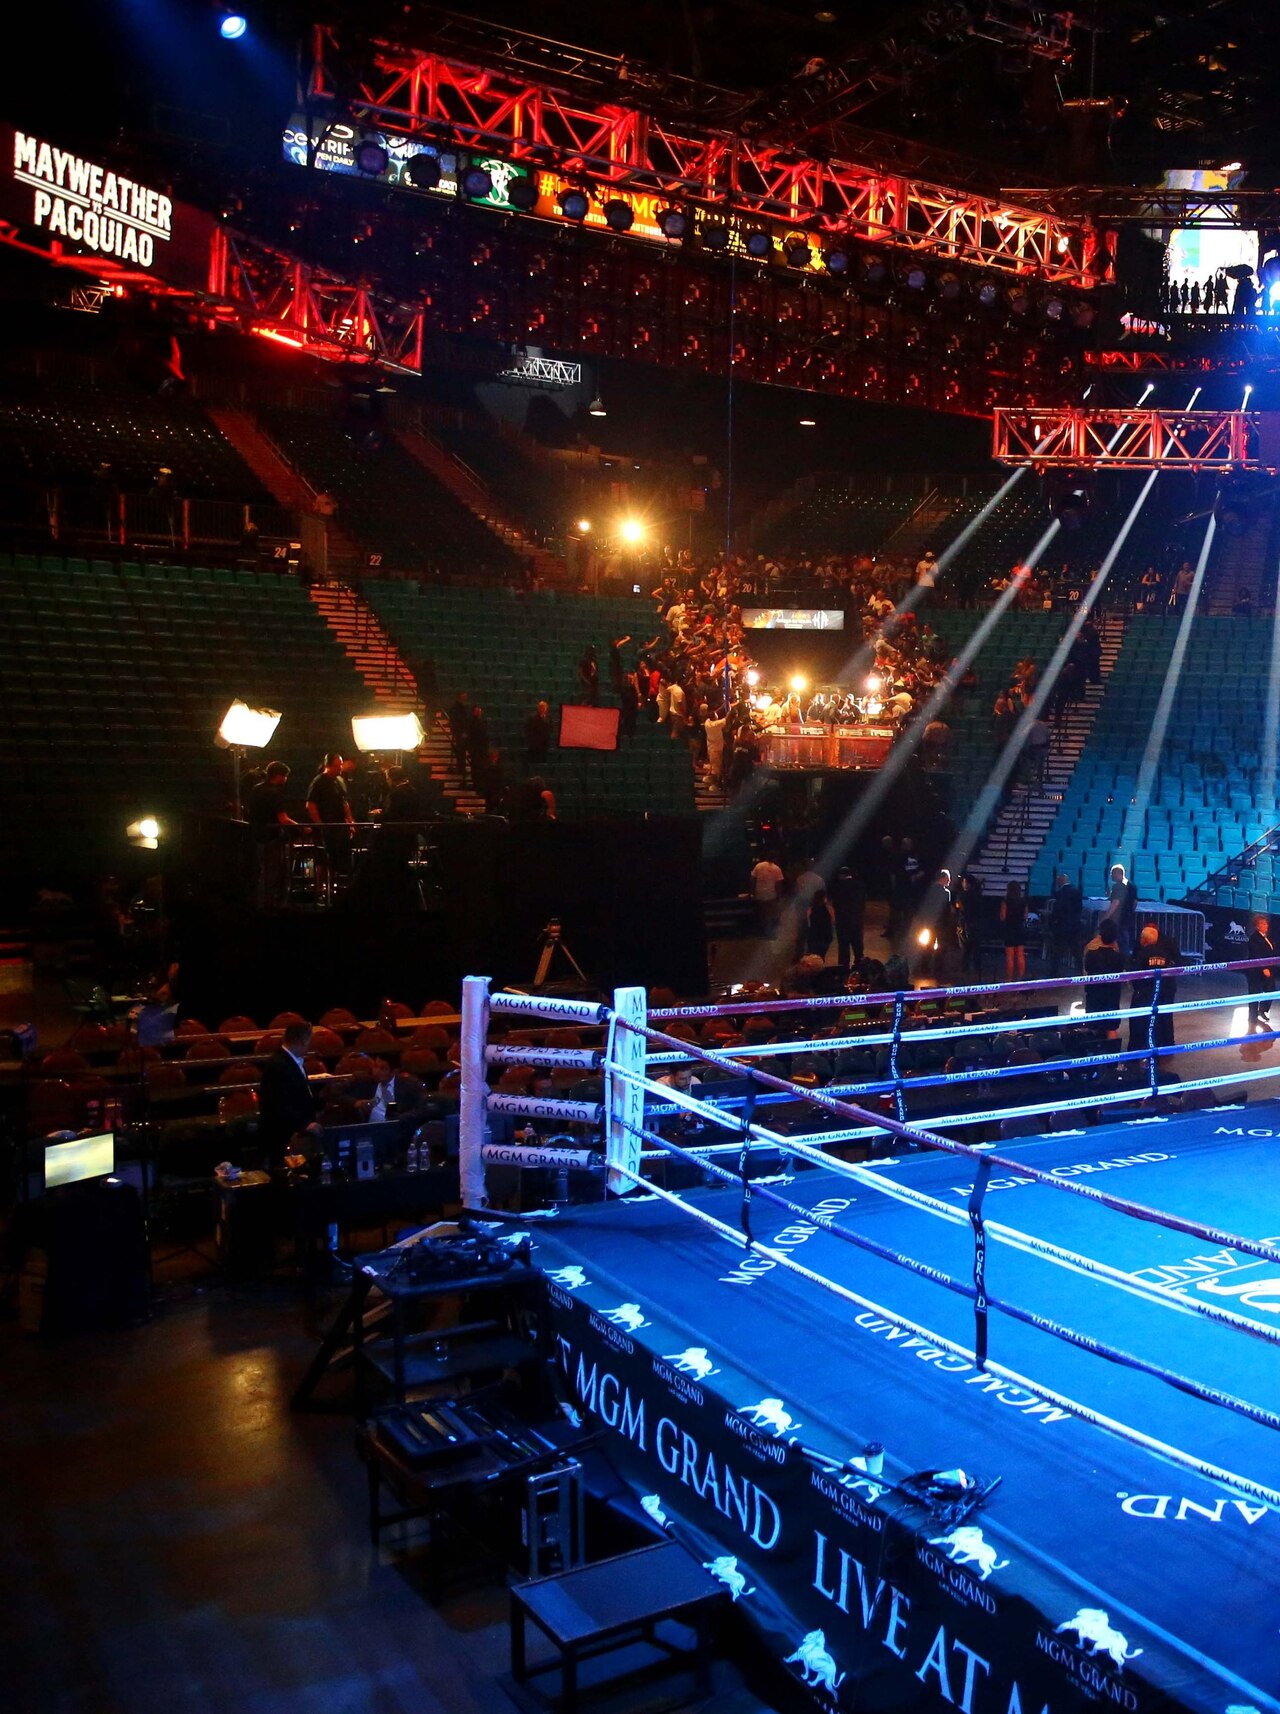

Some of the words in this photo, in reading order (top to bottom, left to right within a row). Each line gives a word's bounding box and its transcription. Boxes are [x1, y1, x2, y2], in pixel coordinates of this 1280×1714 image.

[13, 131, 173, 231] MAYWEATHER
[92, 201, 103, 215] VS
[35, 190, 154, 268] PACQUIAO
[274, 547, 287, 558] 24
[369, 554, 382, 566] 22
[742, 583, 752, 593] 20
[945, 987, 969, 995] MGM
[969, 984, 1000, 993] GRAND
[495, 996, 533, 1010] MGM
[536, 1000, 590, 1017] GRAND
[806, 998, 832, 1006] MGM
[833, 995, 867, 1004] GRAND
[651, 1007, 677, 1017] MGM
[679, 1005, 718, 1015] GRAND
[632, 993, 643, 1060] MGM
[946, 1073, 969, 1081] MGM
[969, 1069, 1000, 1079] GRAND
[493, 1102, 530, 1114] MGM
[534, 1105, 588, 1120] GRAND
[487, 1149, 523, 1162] MGM
[527, 1152, 580, 1168] GRAND
[588, 1312, 608, 1338] MGM
[607, 1322, 635, 1355] GRAND
[652, 1359, 673, 1384] MGM
[673, 1375, 704, 1406] GRAND
[724, 1412, 748, 1439] MGM
[749, 1430, 786, 1465] GRAND
[811, 1470, 838, 1502] MGM
[840, 1491, 883, 1533] GRAND
[574, 1350, 648, 1452] MGM
[655, 1416, 782, 1553] GRAND
[812, 1529, 911, 1661] LIVE
[915, 1624, 992, 1714] AT
[1035, 1630, 1075, 1671] MGM
[1079, 1659, 1138, 1713] GRAND
